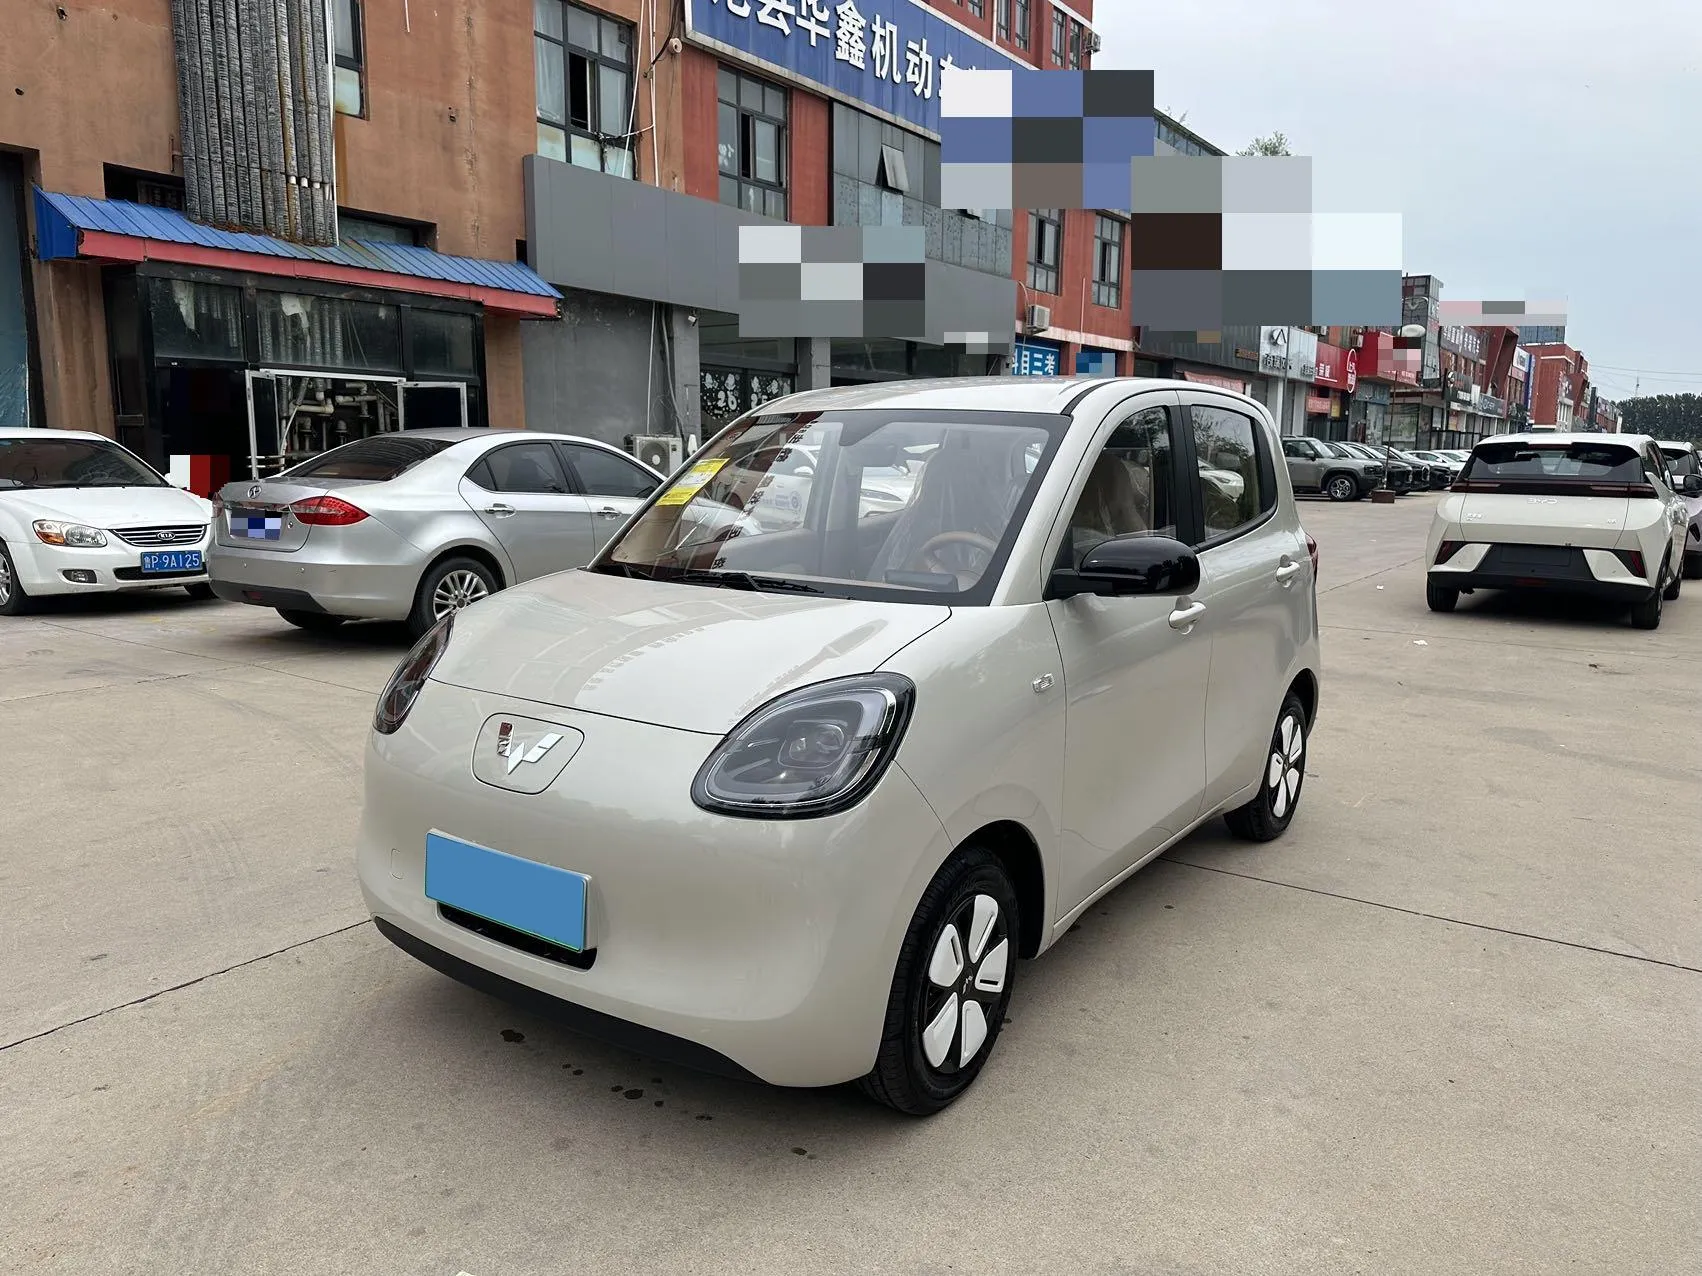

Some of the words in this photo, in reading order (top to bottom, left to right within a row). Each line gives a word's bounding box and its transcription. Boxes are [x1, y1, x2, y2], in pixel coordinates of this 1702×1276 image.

[711, 0, 963, 99] 县华鑫机动
